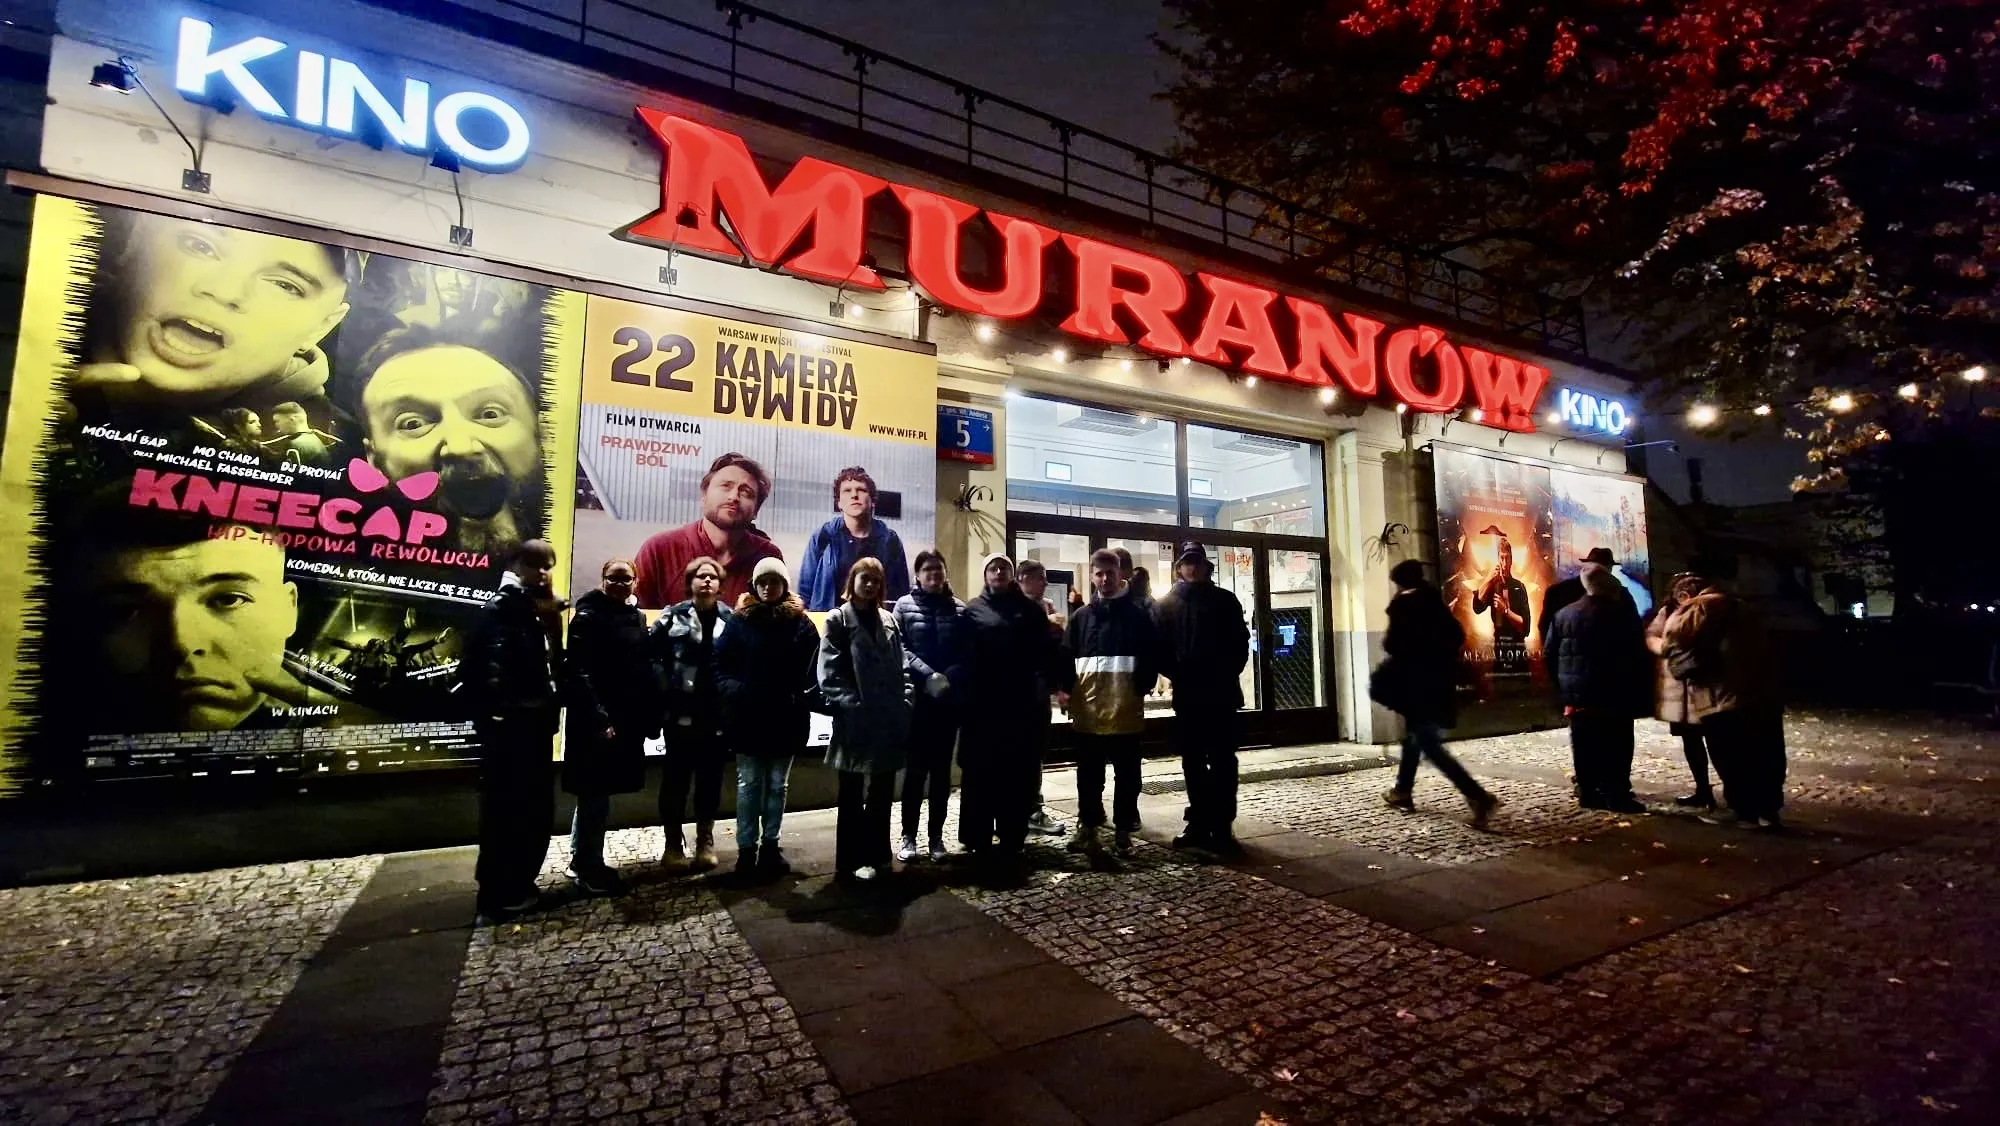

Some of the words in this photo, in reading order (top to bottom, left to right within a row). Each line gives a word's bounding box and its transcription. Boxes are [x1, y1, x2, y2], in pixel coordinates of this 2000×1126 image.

[175, 15, 531, 166] KINO
[610, 104, 1553, 432] MURANÓW
[718, 326, 759, 343] WARSAW
[760, 333, 793, 347] JEWISH
[611, 327, 696, 392] 22
[715, 341, 858, 397] KAMERA
[606, 413, 636, 426] FILM
[639, 417, 702, 435] OTWARCIA
[1561, 388, 1625, 435] KINO
[81, 422, 143, 443] MÓGLAÍ
[139, 435, 168, 448] BAP
[868, 423, 928, 441] WWW.WJFF.PL
[956, 419, 971, 448] 5
[192, 445, 216, 458] MO
[218, 450, 260, 466] CHARA
[600, 435, 702, 457] PRAWDZIWY
[155, 452, 214, 472] MICHAEL
[216, 463, 295, 486] FASSBENDER
[280, 461, 298, 473] DJ
[298, 466, 347, 481] PROVAÍ
[635, 452, 668, 468] BÓL
[129, 468, 447, 545] KNEECAP
[370, 542, 490, 569] REWOLUCJA
[286, 558, 345, 578] KOMEDIA,
[347, 566, 385, 583] KTÓRA
[387, 575, 408, 586] NIE
[408, 578, 439, 591] LICZY
[439, 584, 456, 597] SIĘ
[456, 587, 471, 597] ZE
[472, 589, 497, 601] SŁO
[271, 707, 283, 717] W
[288, 705, 339, 717] KINACH
